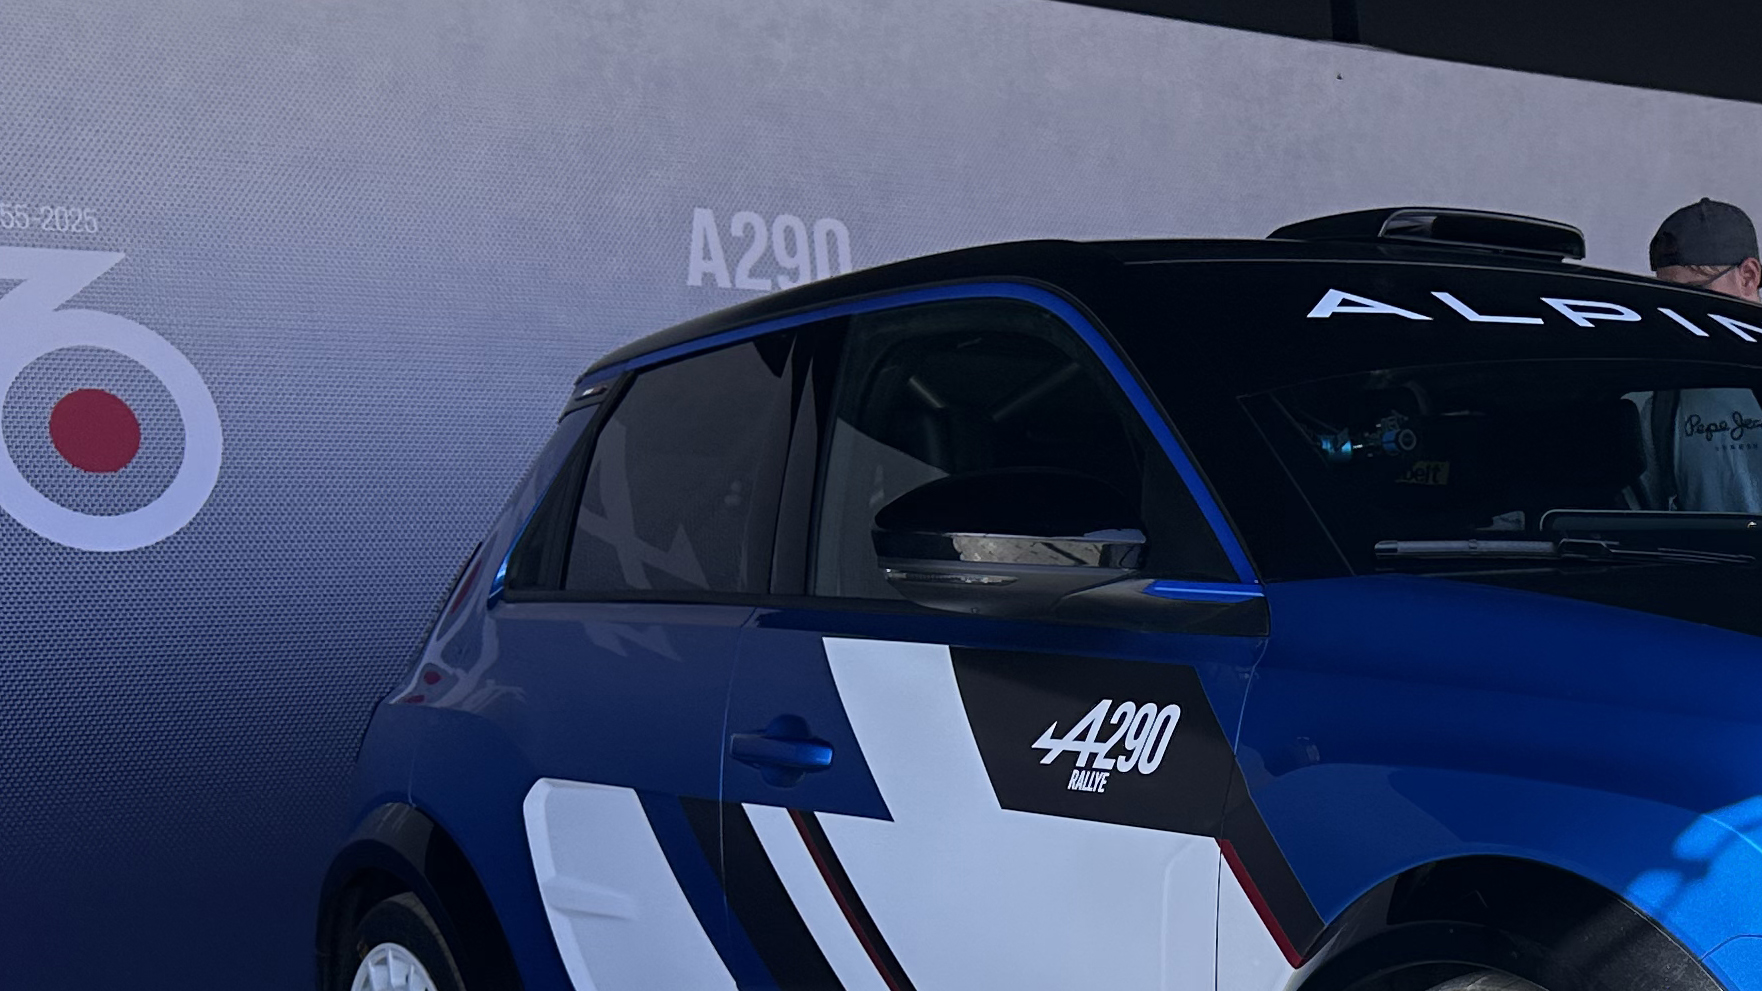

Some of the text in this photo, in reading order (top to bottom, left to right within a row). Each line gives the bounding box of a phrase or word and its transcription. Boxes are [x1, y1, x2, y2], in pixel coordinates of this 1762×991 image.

[687, 207, 852, 290] A290
[1031, 699, 1181, 775] A290
[1067, 769, 1110, 793] RALLYE
